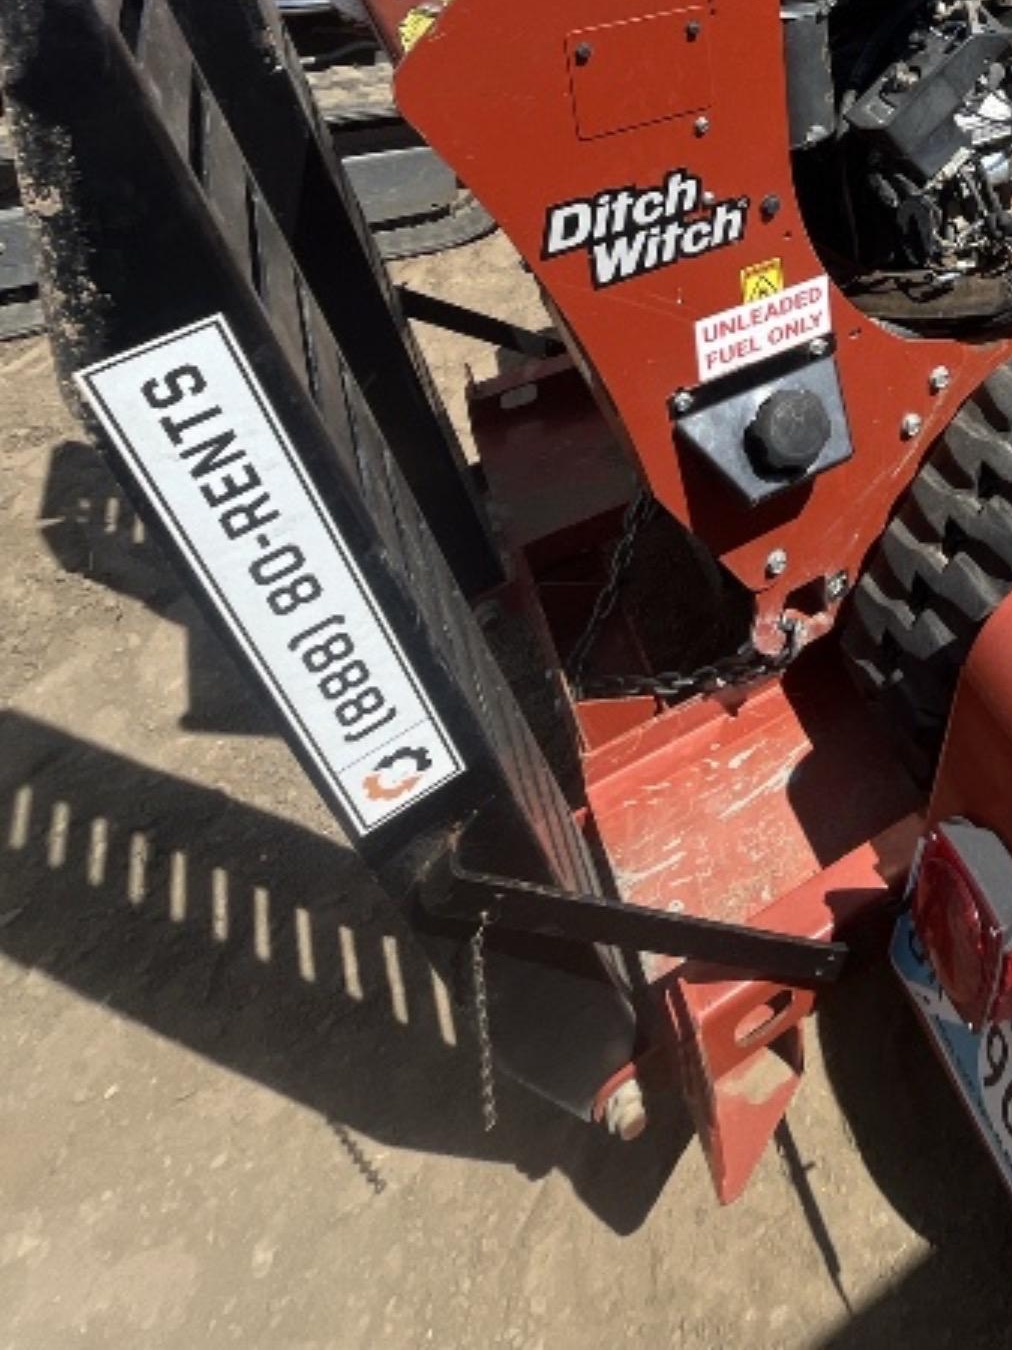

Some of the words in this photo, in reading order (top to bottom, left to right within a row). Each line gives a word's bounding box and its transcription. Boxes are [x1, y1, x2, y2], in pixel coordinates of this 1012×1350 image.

[546, 170, 699, 255] Ditch
[591, 201, 744, 286] Witch
[702, 286, 823, 344] UNLEADED
[704, 334, 763, 371] FUEL
[766, 310, 824, 346] ONLY
[140, 361, 325, 618] 80-RENTS
[287, 613, 398, 744] (888)
